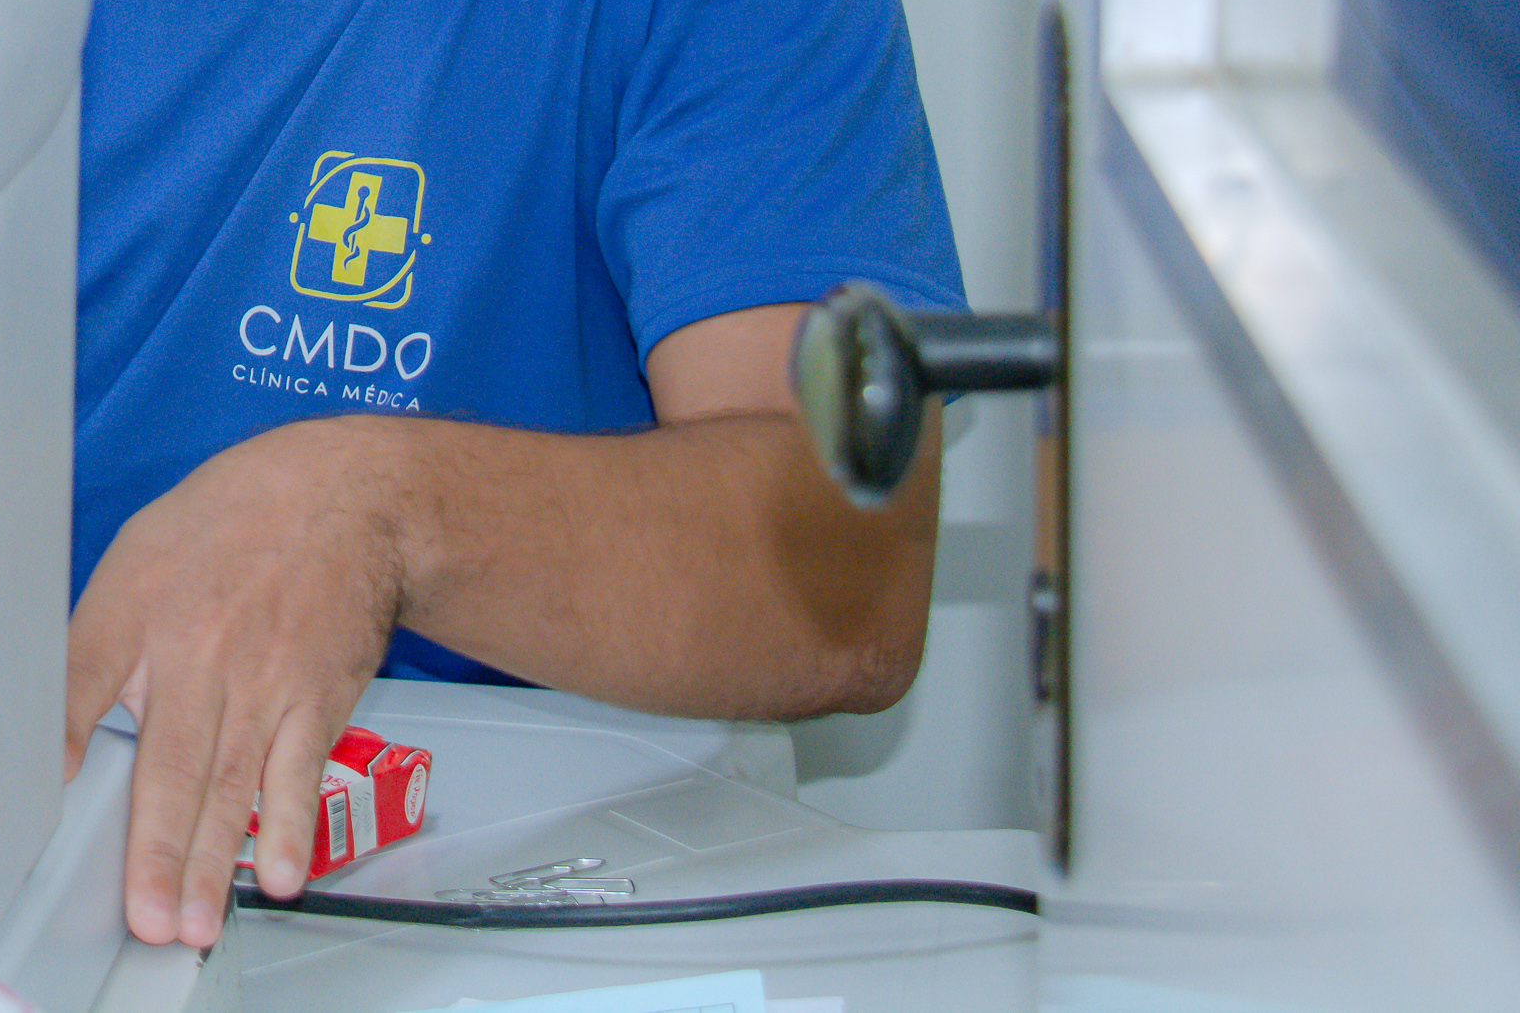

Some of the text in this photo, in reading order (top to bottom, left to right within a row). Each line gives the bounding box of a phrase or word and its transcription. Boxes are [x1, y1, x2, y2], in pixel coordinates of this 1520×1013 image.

[239, 305, 431, 380] CMDO
[232, 364, 420, 411] CLÍNICA MÉDICA
